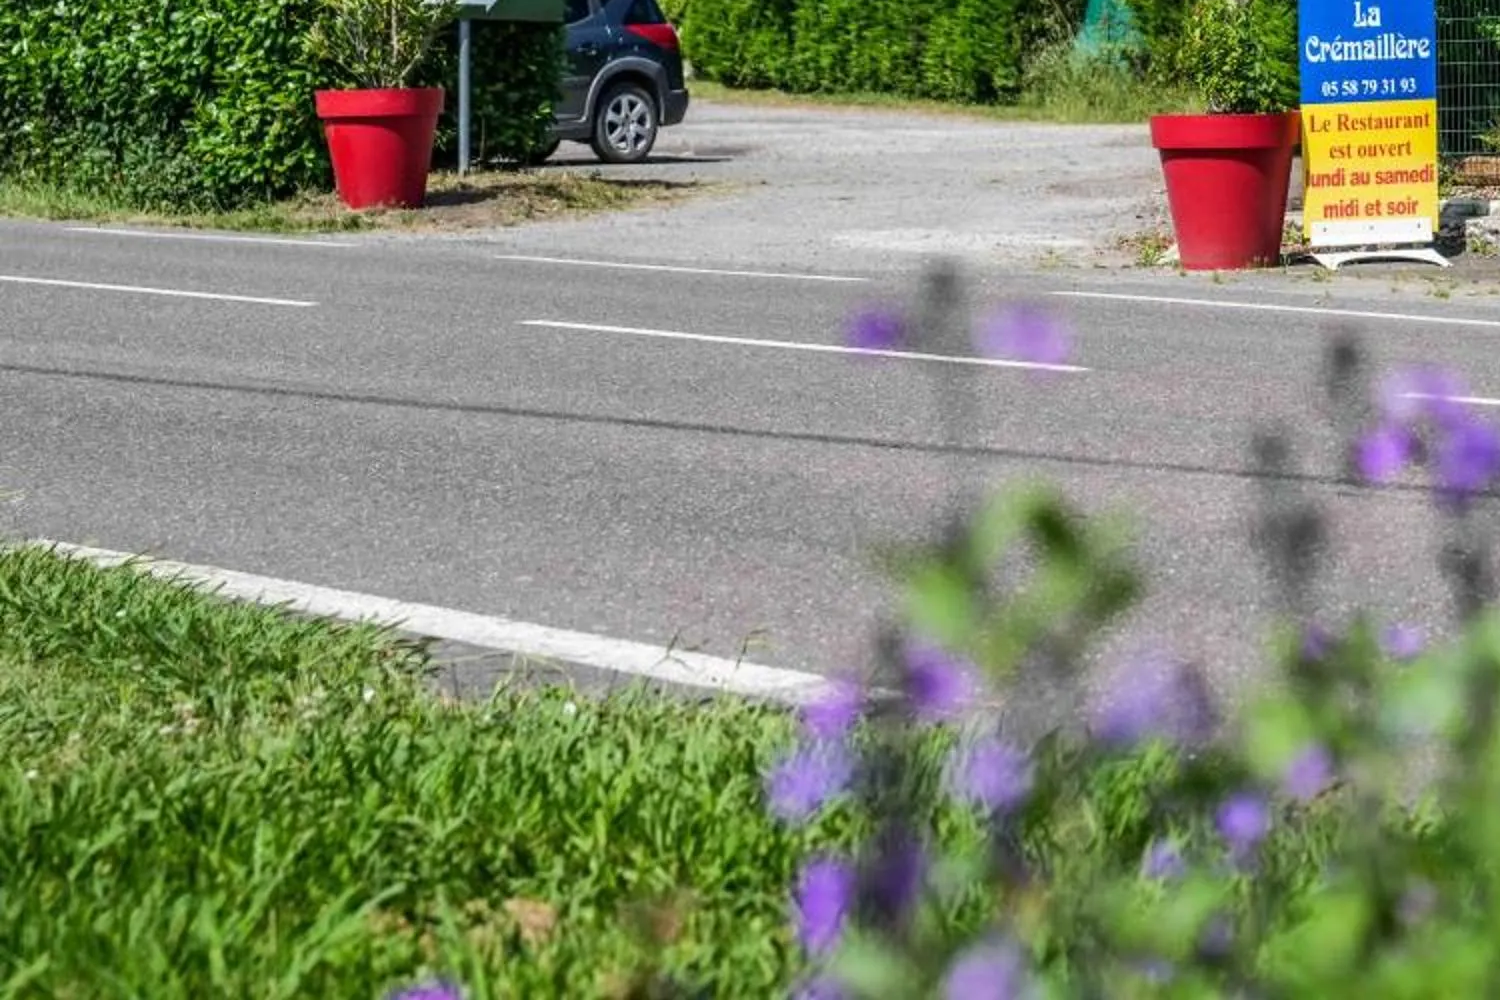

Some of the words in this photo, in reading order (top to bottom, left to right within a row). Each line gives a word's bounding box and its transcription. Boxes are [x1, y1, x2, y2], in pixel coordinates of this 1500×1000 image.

[1353, 1, 1382, 27] La
[1305, 33, 1430, 62] Crémaillère
[1321, 81, 1338, 97] 05
[1341, 80, 1359, 96] 58
[1361, 79, 1378, 95] 79
[1381, 78, 1395, 94] 31
[1400, 77, 1417, 93] 93
[1310, 114, 1331, 132] Le
[1337, 112, 1430, 131] Restaurant
[1329, 144, 1352, 159] est
[1357, 141, 1412, 157] ouvert
[1305, 168, 1345, 188] lundi
[1350, 171, 1370, 186] au
[1375, 164, 1434, 184] samedi
[1323, 199, 1359, 219] midi
[1365, 200, 1382, 217] et
[1387, 196, 1419, 215] soir
